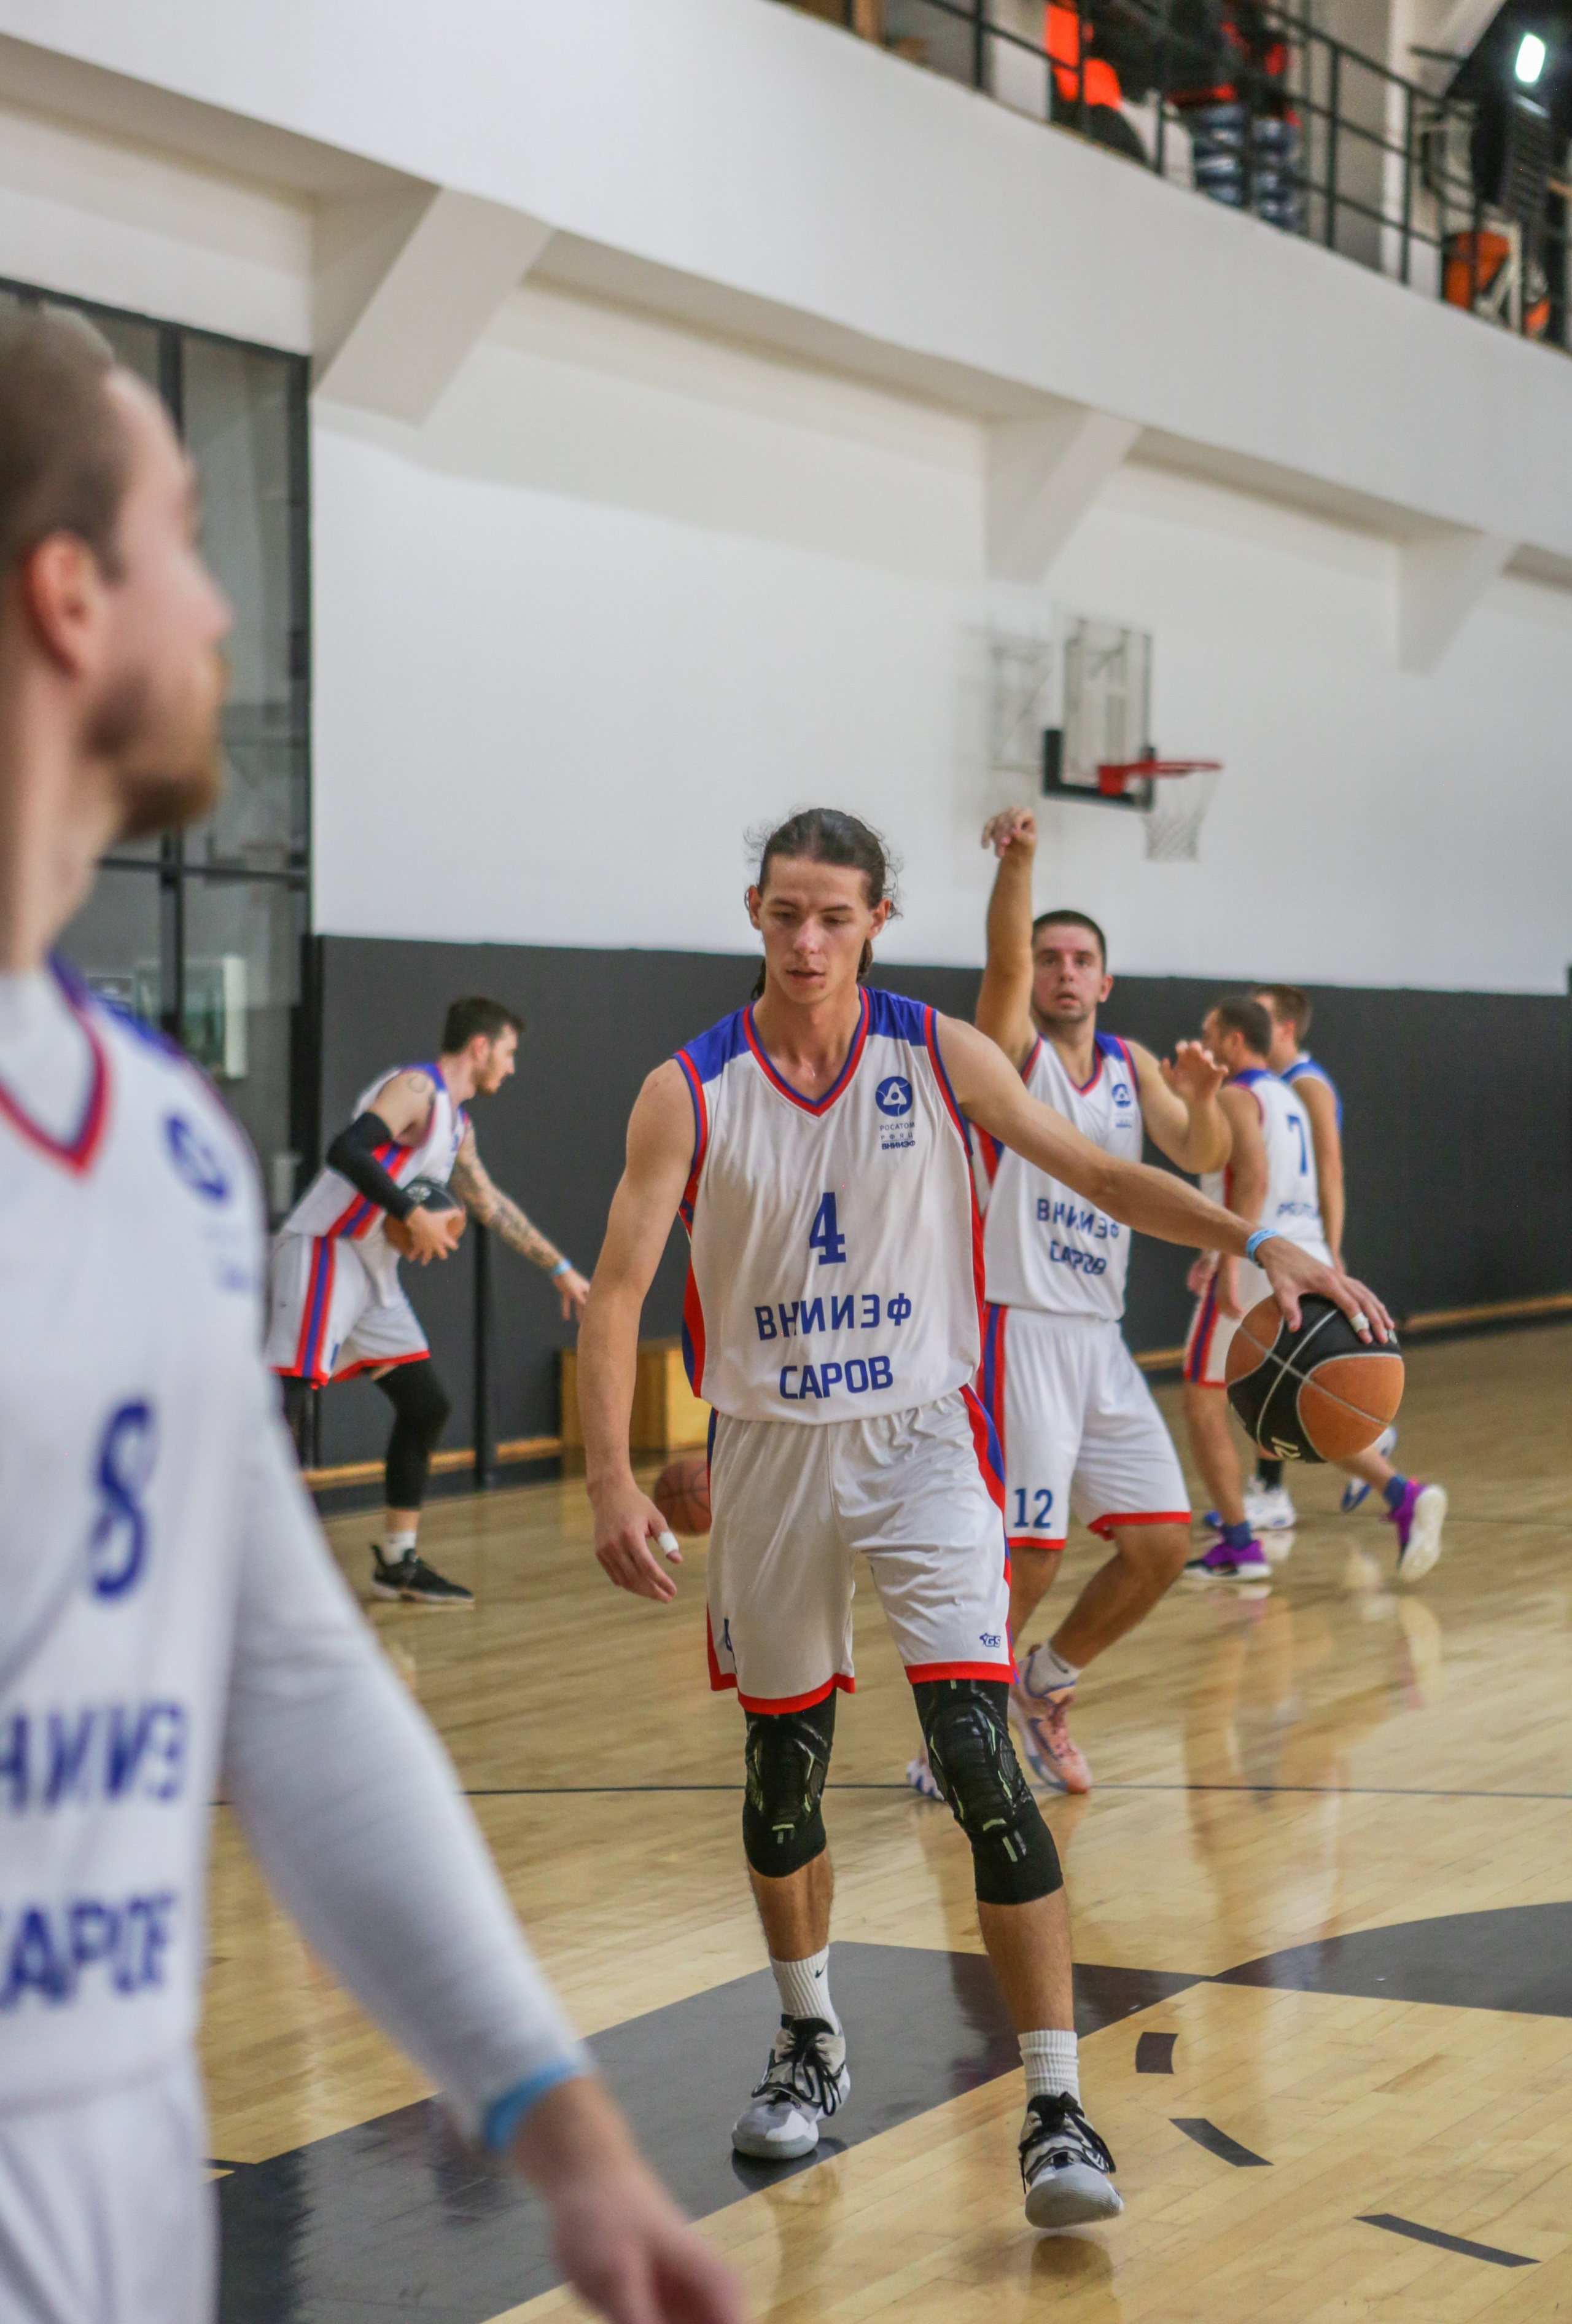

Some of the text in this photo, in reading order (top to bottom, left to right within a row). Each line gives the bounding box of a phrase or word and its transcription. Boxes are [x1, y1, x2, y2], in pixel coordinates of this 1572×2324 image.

[880, 1122, 915, 1131] РОСАТОМ
[881, 1141, 916, 1150] ВНИИЭФ
[1286, 1114, 1307, 1176] 7
[809, 1192, 846, 1265] 4
[755, 1293, 912, 1340] ВНИИЭФ
[779, 1355, 893, 1399] САРОВ
[1014, 1488, 1053, 1529] 12
